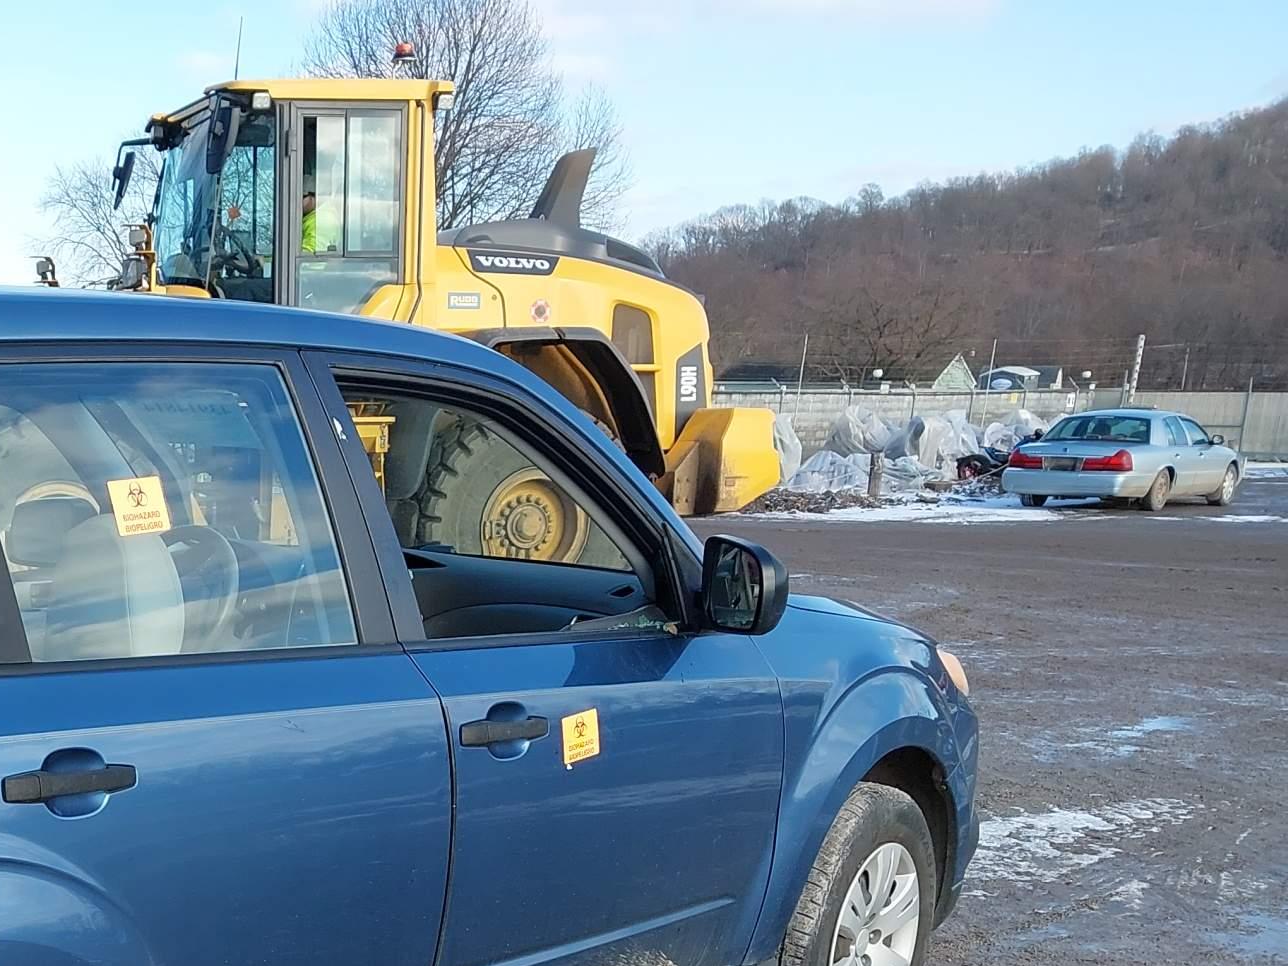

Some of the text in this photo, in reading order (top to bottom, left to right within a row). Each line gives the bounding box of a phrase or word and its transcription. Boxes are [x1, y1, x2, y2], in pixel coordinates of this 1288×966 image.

[475, 256, 551, 270] VOLVO
[679, 366, 698, 402] L90H
[122, 510, 161, 522] BIOHAZARD
[125, 521, 164, 533] BIOPELIGRO
